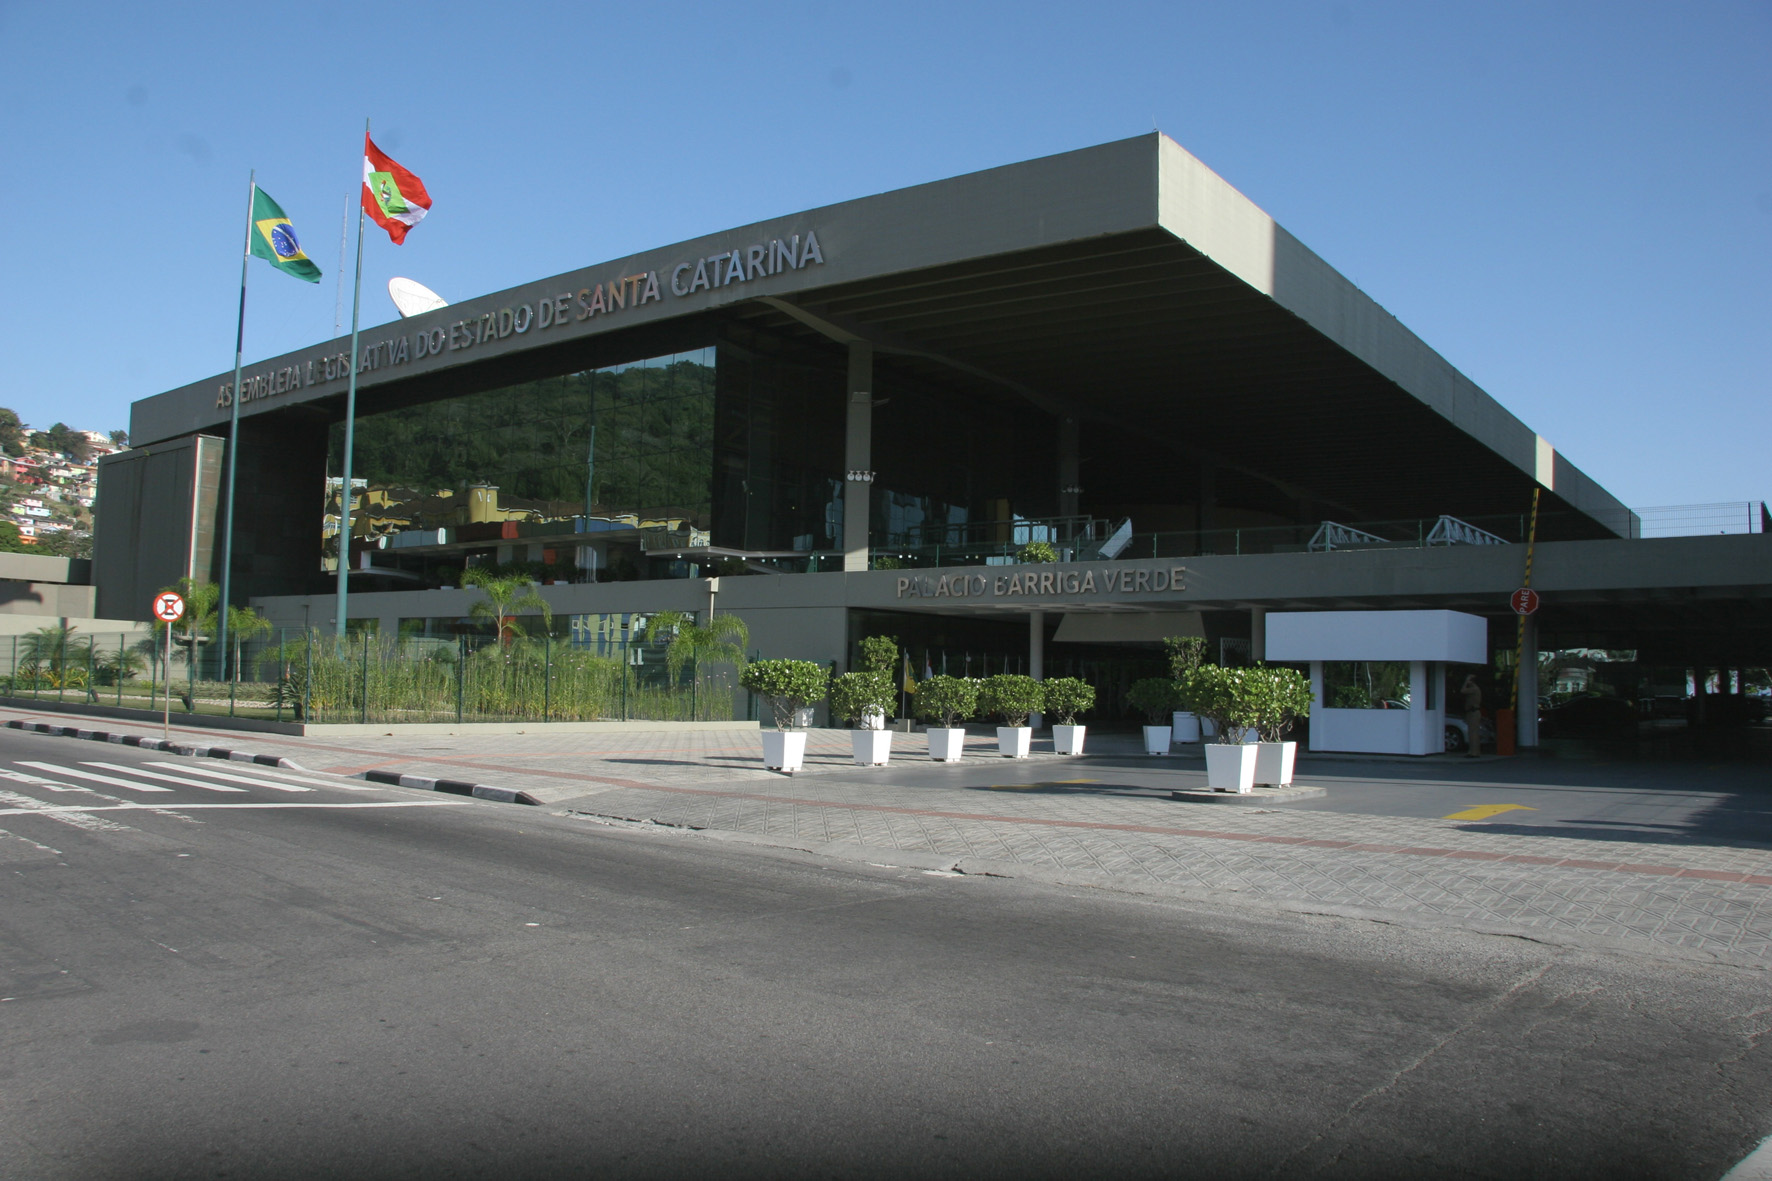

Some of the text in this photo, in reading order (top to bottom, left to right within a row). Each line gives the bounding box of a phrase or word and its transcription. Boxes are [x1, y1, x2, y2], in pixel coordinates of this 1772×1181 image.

[216, 230, 824, 408] ASEMBLEIA LEGISATIVA DO ESTADO DE SANTA CATARINA
[994, 571, 1096, 596] BARRIGA
[1103, 566, 1186, 592] VERDE
[1520, 590, 1530, 614] PARE
